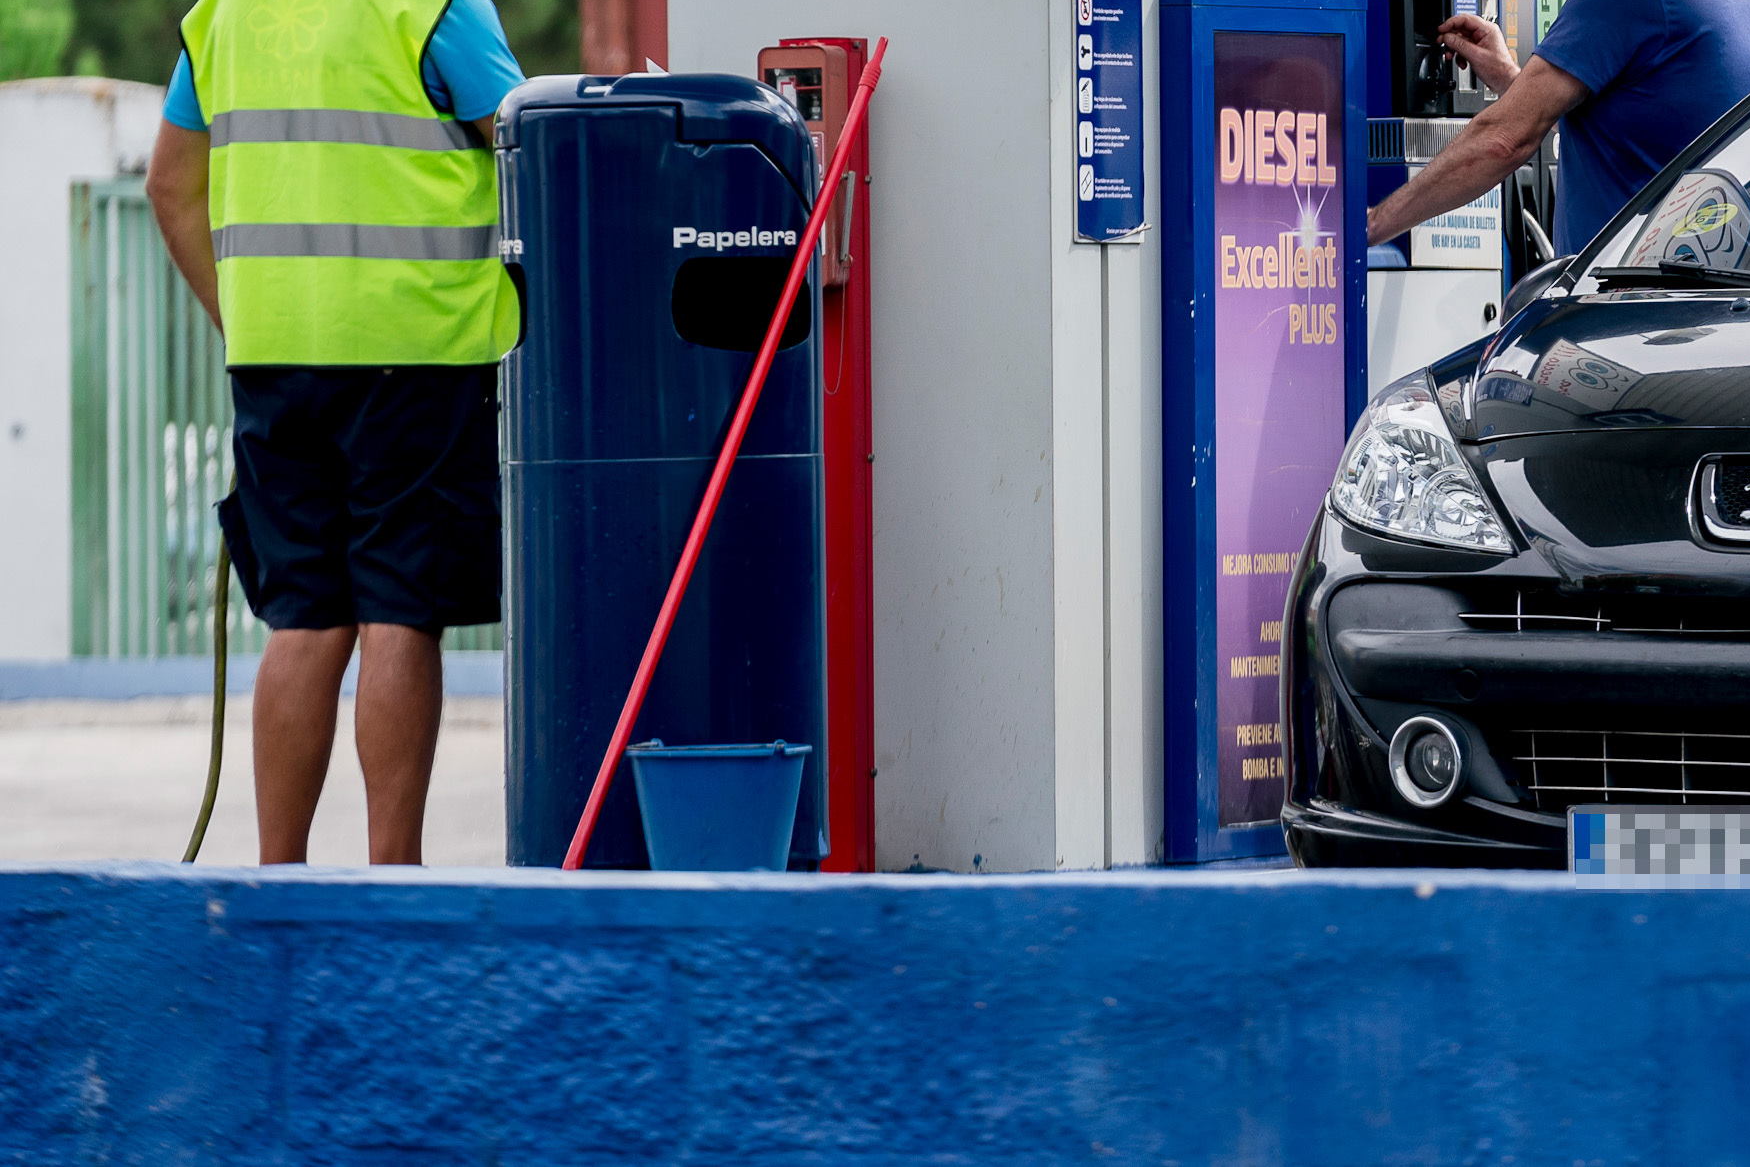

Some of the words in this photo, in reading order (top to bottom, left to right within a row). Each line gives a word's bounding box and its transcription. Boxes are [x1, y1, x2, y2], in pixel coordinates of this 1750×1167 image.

[1220, 108, 1337, 186] DIESEL
[1469, 216, 1475, 229] DE
[1476, 217, 1496, 230] BILLETES
[673, 225, 797, 252] Papelera
[1432, 233, 1440, 249] QUE
[1441, 234, 1450, 248] HAY
[1451, 234, 1456, 248] EN
[1457, 235, 1462, 248] LA
[1463, 235, 1480, 249] CASETA
[1221, 233, 1337, 289] Excellent
[1288, 303, 1337, 345] PLUS
[1222, 554, 1253, 575] MEJORA
[1253, 552, 1290, 575] CONSUMO
[1230, 654, 1281, 679] MANTENIMIE
[1237, 723, 1273, 747] PREVIENE
[1242, 757, 1269, 781] BOMBA
[1270, 757, 1276, 776] E
